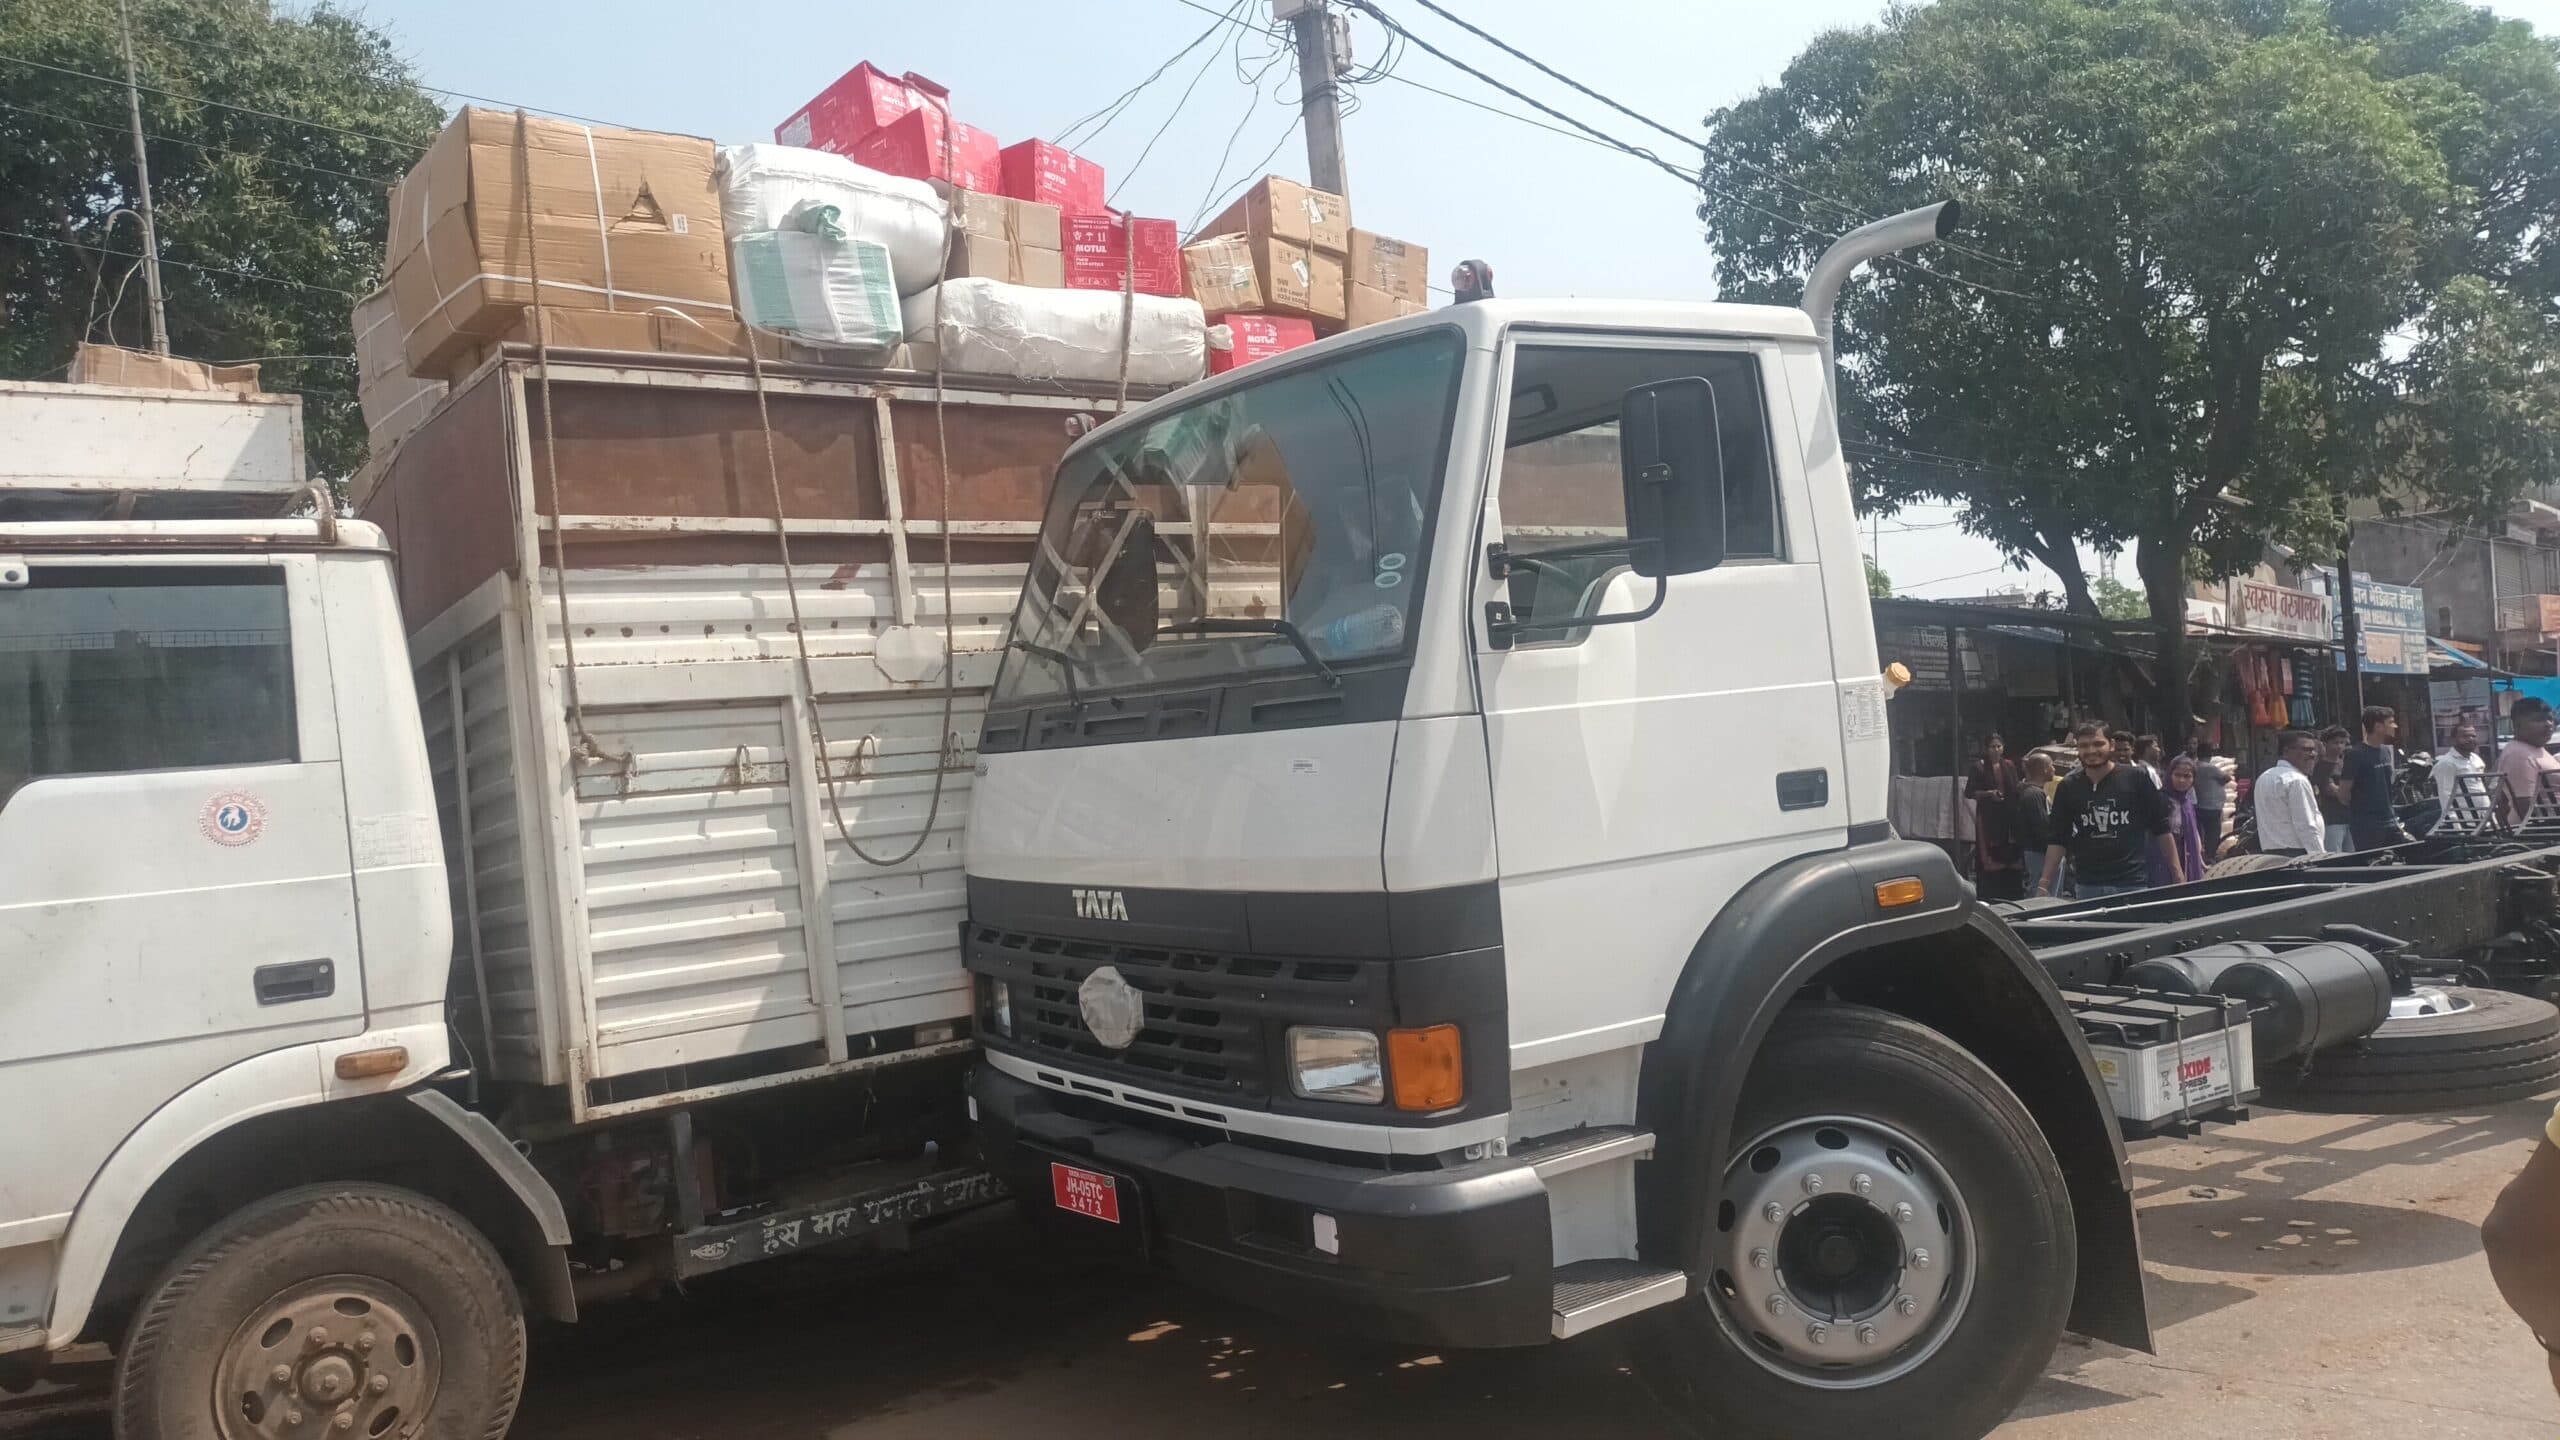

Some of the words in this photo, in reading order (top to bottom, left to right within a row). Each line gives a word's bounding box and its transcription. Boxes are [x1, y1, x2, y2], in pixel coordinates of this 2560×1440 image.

[1043, 171, 1067, 186] MOTUL
[1075, 244, 1107, 254] MOTUL
[2244, 583, 2278, 616] स्वरूप
[1072, 889, 1129, 921] TATA
[1066, 1177, 1104, 1201] JH-05TC
[1070, 1194, 1102, 1215] 3473
